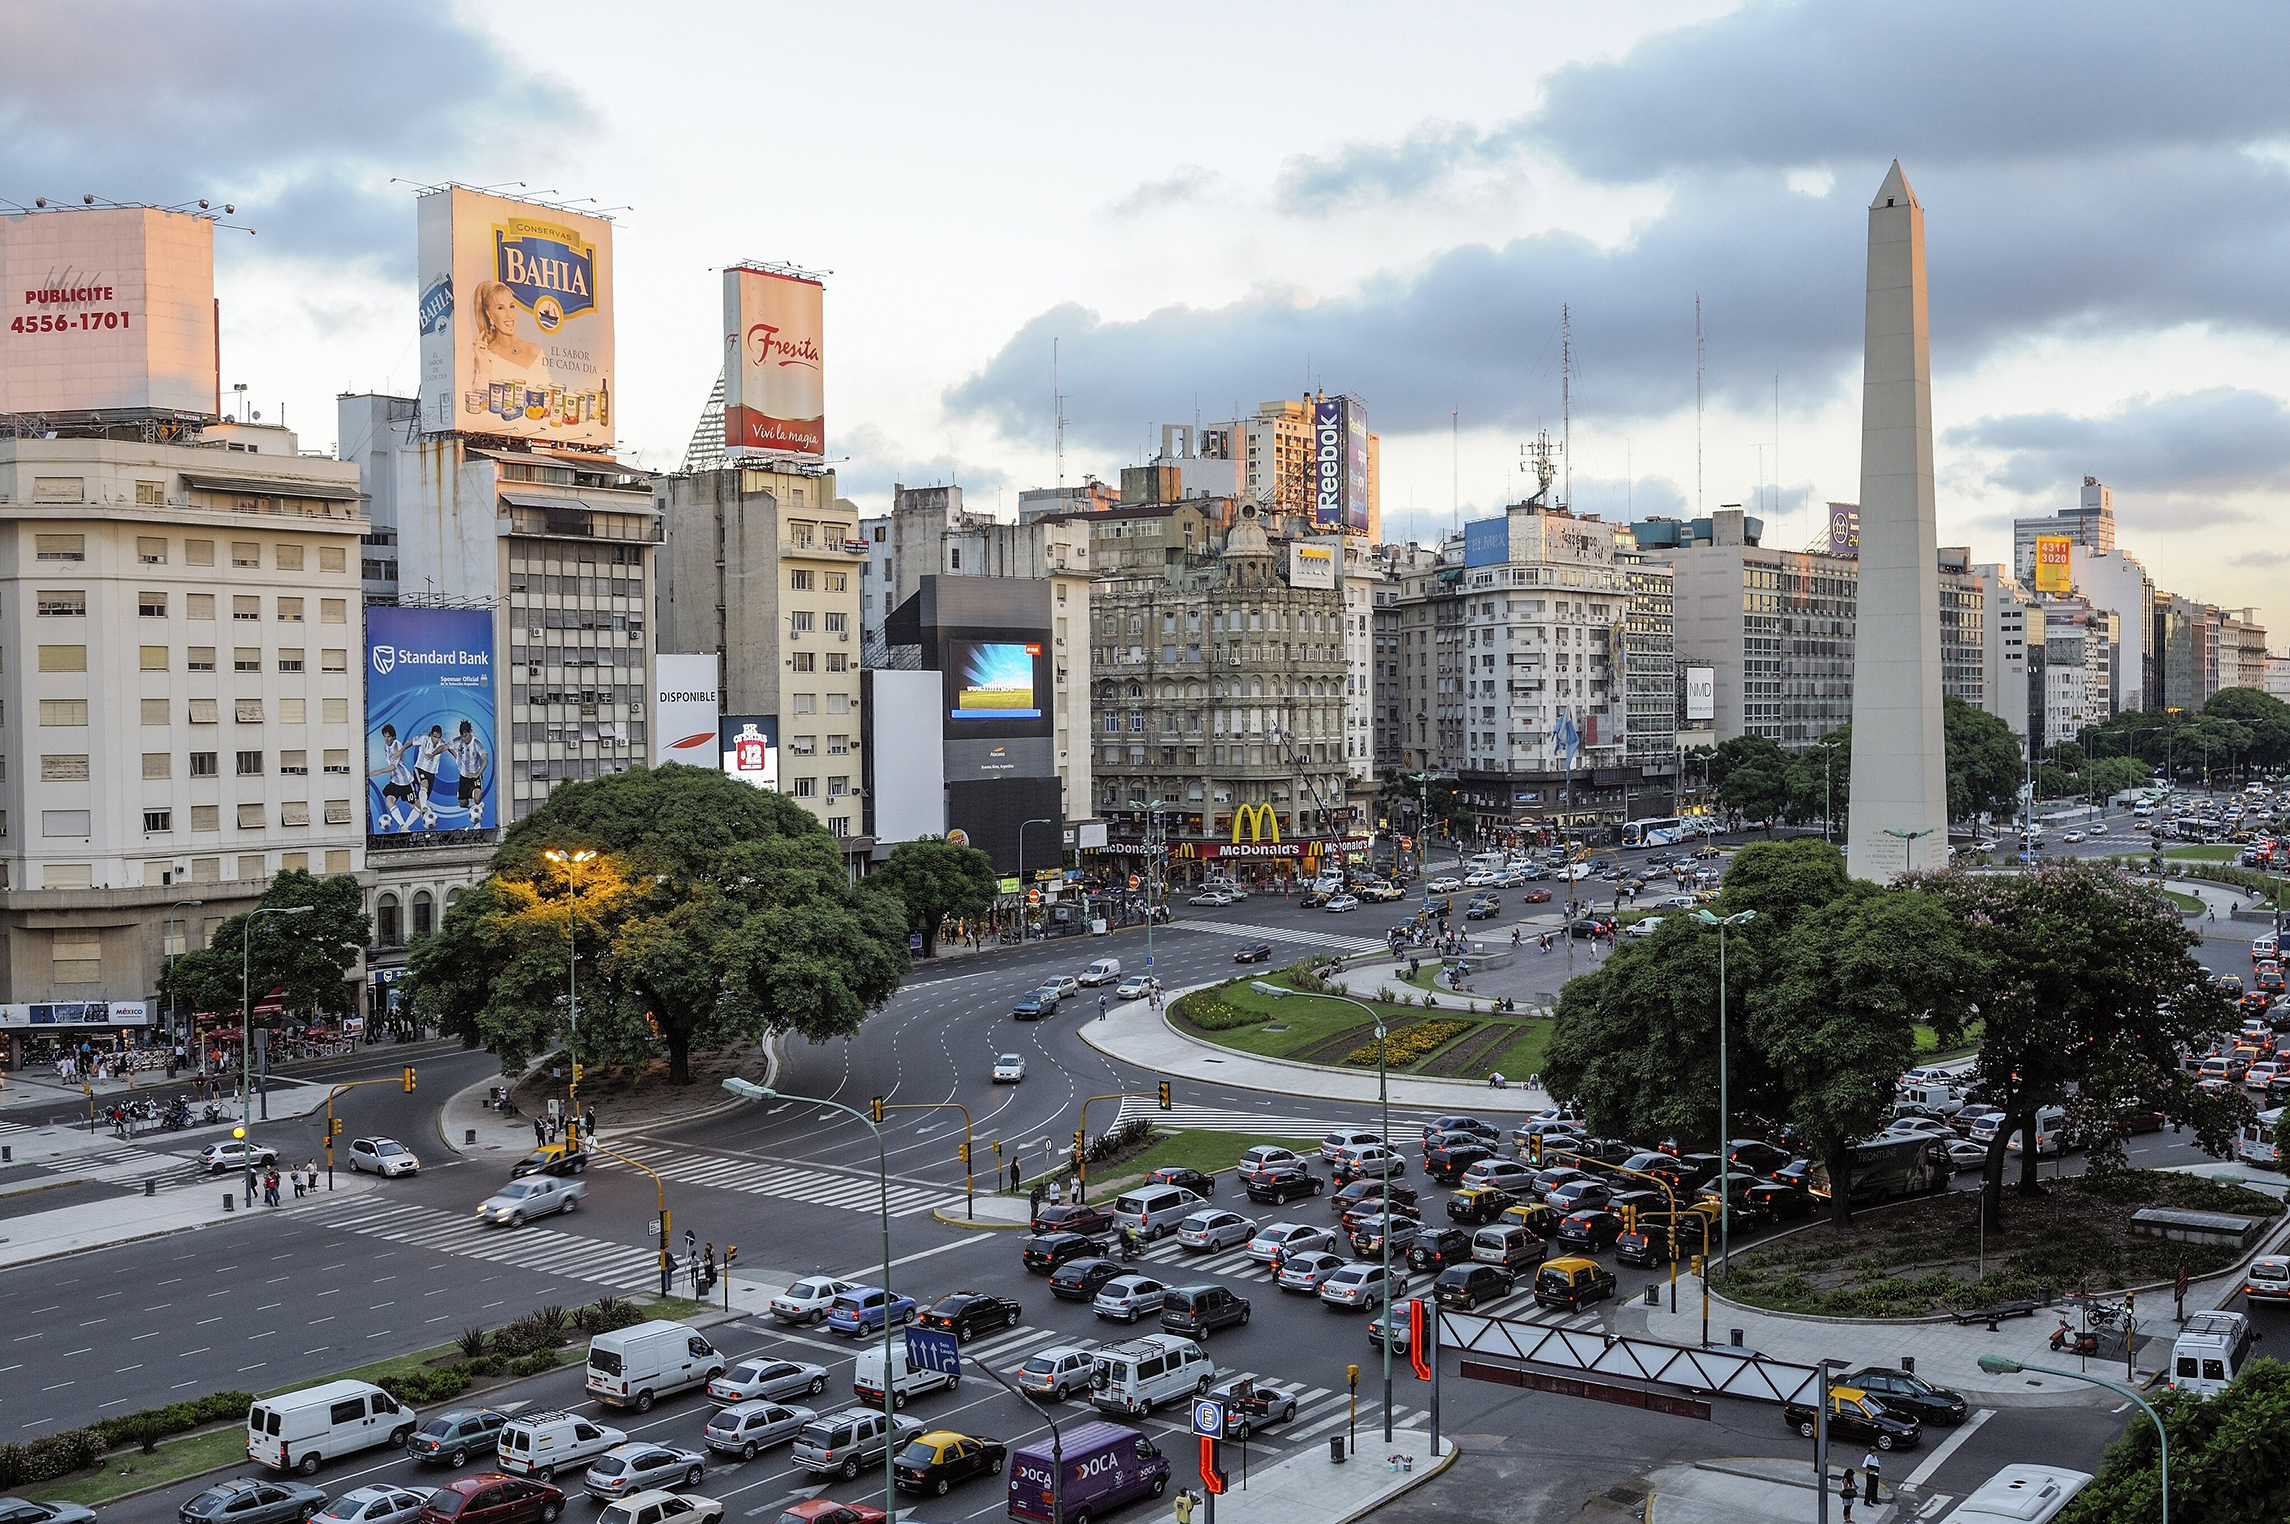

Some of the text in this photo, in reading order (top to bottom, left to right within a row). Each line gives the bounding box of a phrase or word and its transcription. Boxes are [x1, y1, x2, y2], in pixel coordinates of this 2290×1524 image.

[517, 223, 572, 241] CONSERVAS
[504, 246, 589, 297] BAHIA
[25, 287, 113, 304] PUBLICITE
[419, 286, 454, 330] BAHIA
[10, 311, 129, 334] 4556-1701
[747, 323, 819, 364] Fresita
[550, 346, 591, 361] EL SABOR
[542, 357, 554, 367] DE
[555, 359, 581, 373] CADA
[752, 423, 819, 448] Viví la magia
[1317, 413, 1339, 510] Reebok
[2041, 542, 2067, 552] 4311
[2041, 553, 2067, 563] 3020
[398, 649, 489, 665] Standard Bank
[440, 675, 462, 684] Sponsor
[659, 691, 716, 703] DISPONIBLE
[1689, 682, 1711, 697] NMD
[743, 724, 757, 734] BK
[733, 734, 768, 744] OFERTAS
[1219, 844, 1300, 856] McDonald's
[1201, 1407, 1213, 1428] E
[1090, 1451, 1119, 1476] OCA
[1143, 1465, 1157, 1475] OCA
[1028, 1468, 1053, 1485] OCA
